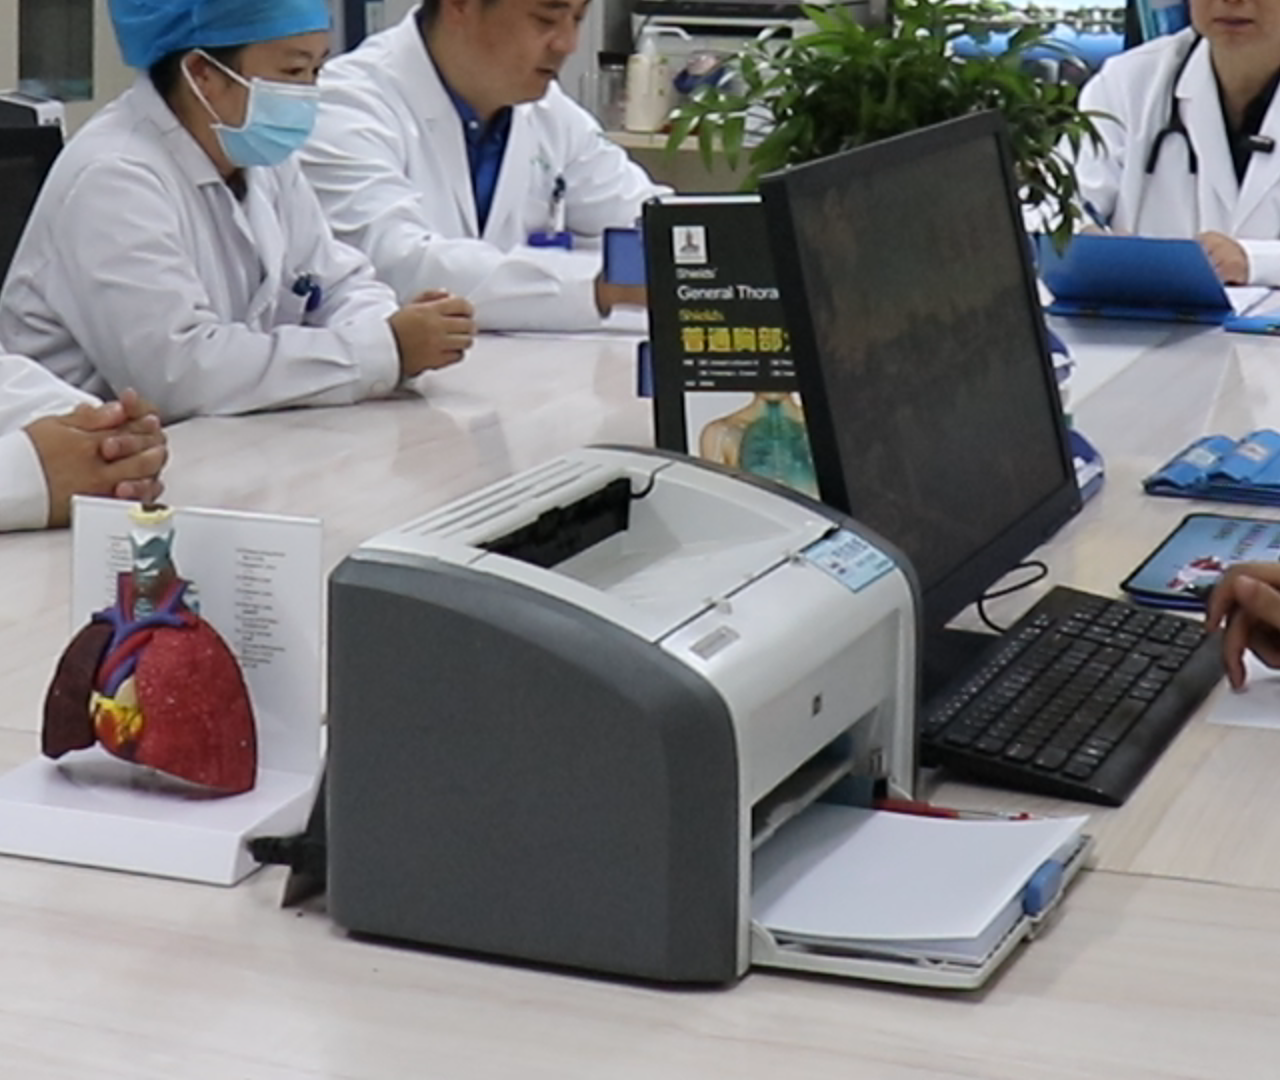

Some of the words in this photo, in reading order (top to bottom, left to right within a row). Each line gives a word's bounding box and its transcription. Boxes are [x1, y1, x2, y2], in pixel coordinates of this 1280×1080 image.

[676, 284, 734, 301] General
[681, 326, 791, 353] 普通胸部
